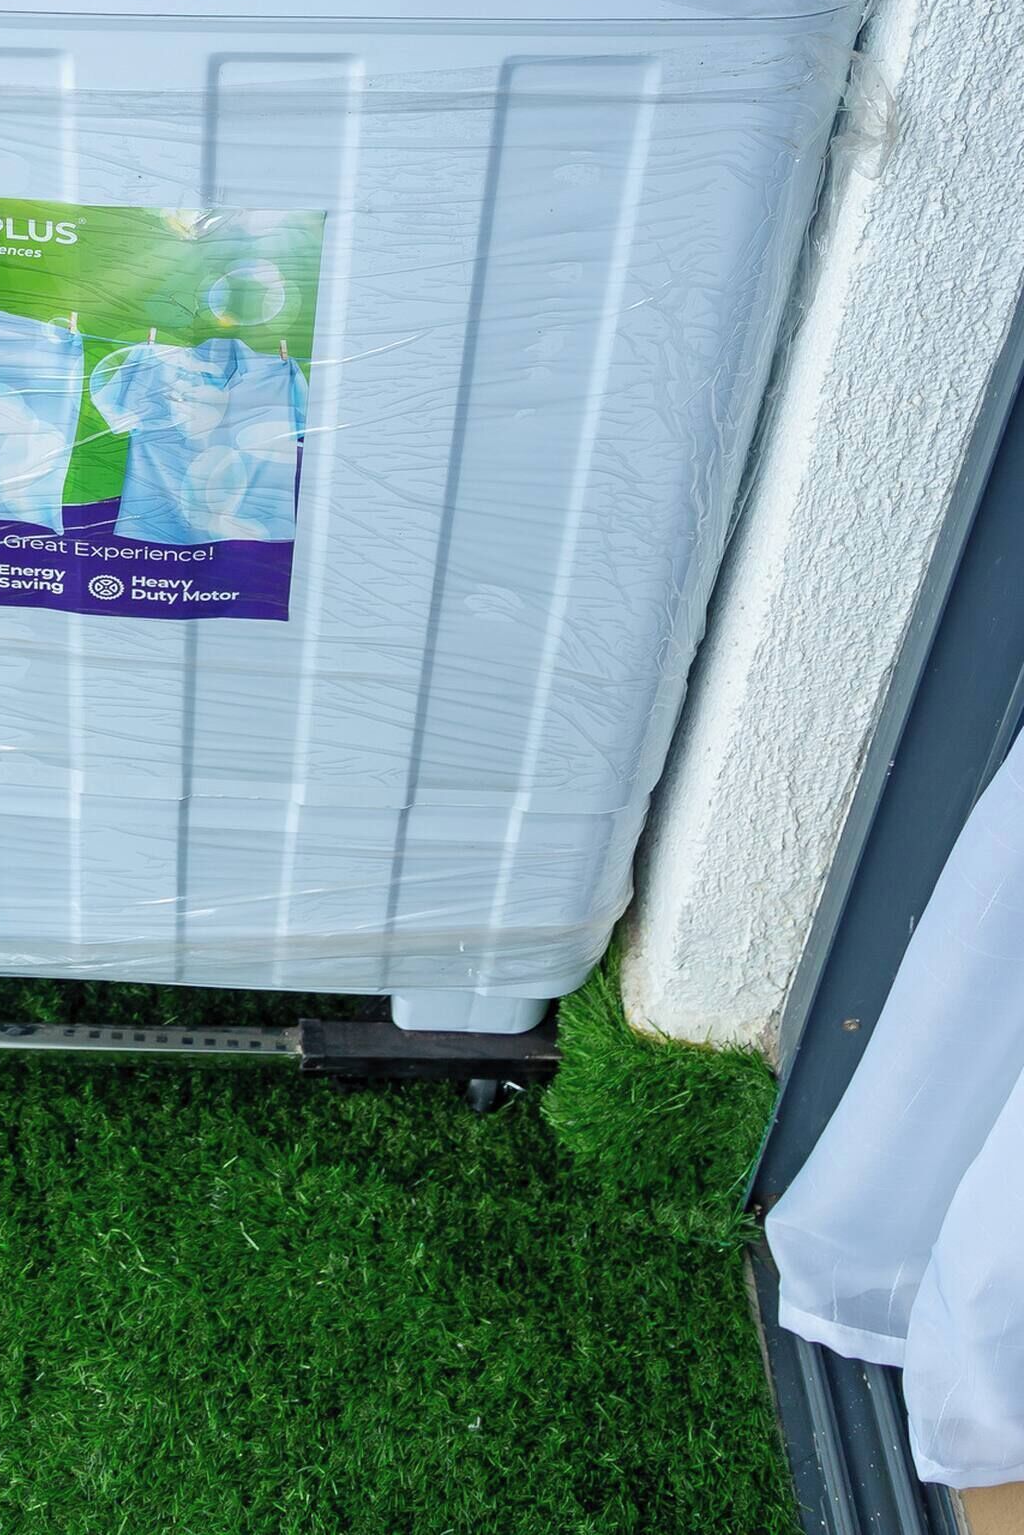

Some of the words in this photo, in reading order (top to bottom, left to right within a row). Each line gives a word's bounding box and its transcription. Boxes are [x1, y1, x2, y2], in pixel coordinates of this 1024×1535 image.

[3, 535, 68, 554] Great
[75, 542, 214, 562] Experience!
[131, 575, 193, 591] Heavy
[131, 589, 179, 604] Duty
[183, 589, 239, 602] Motor
